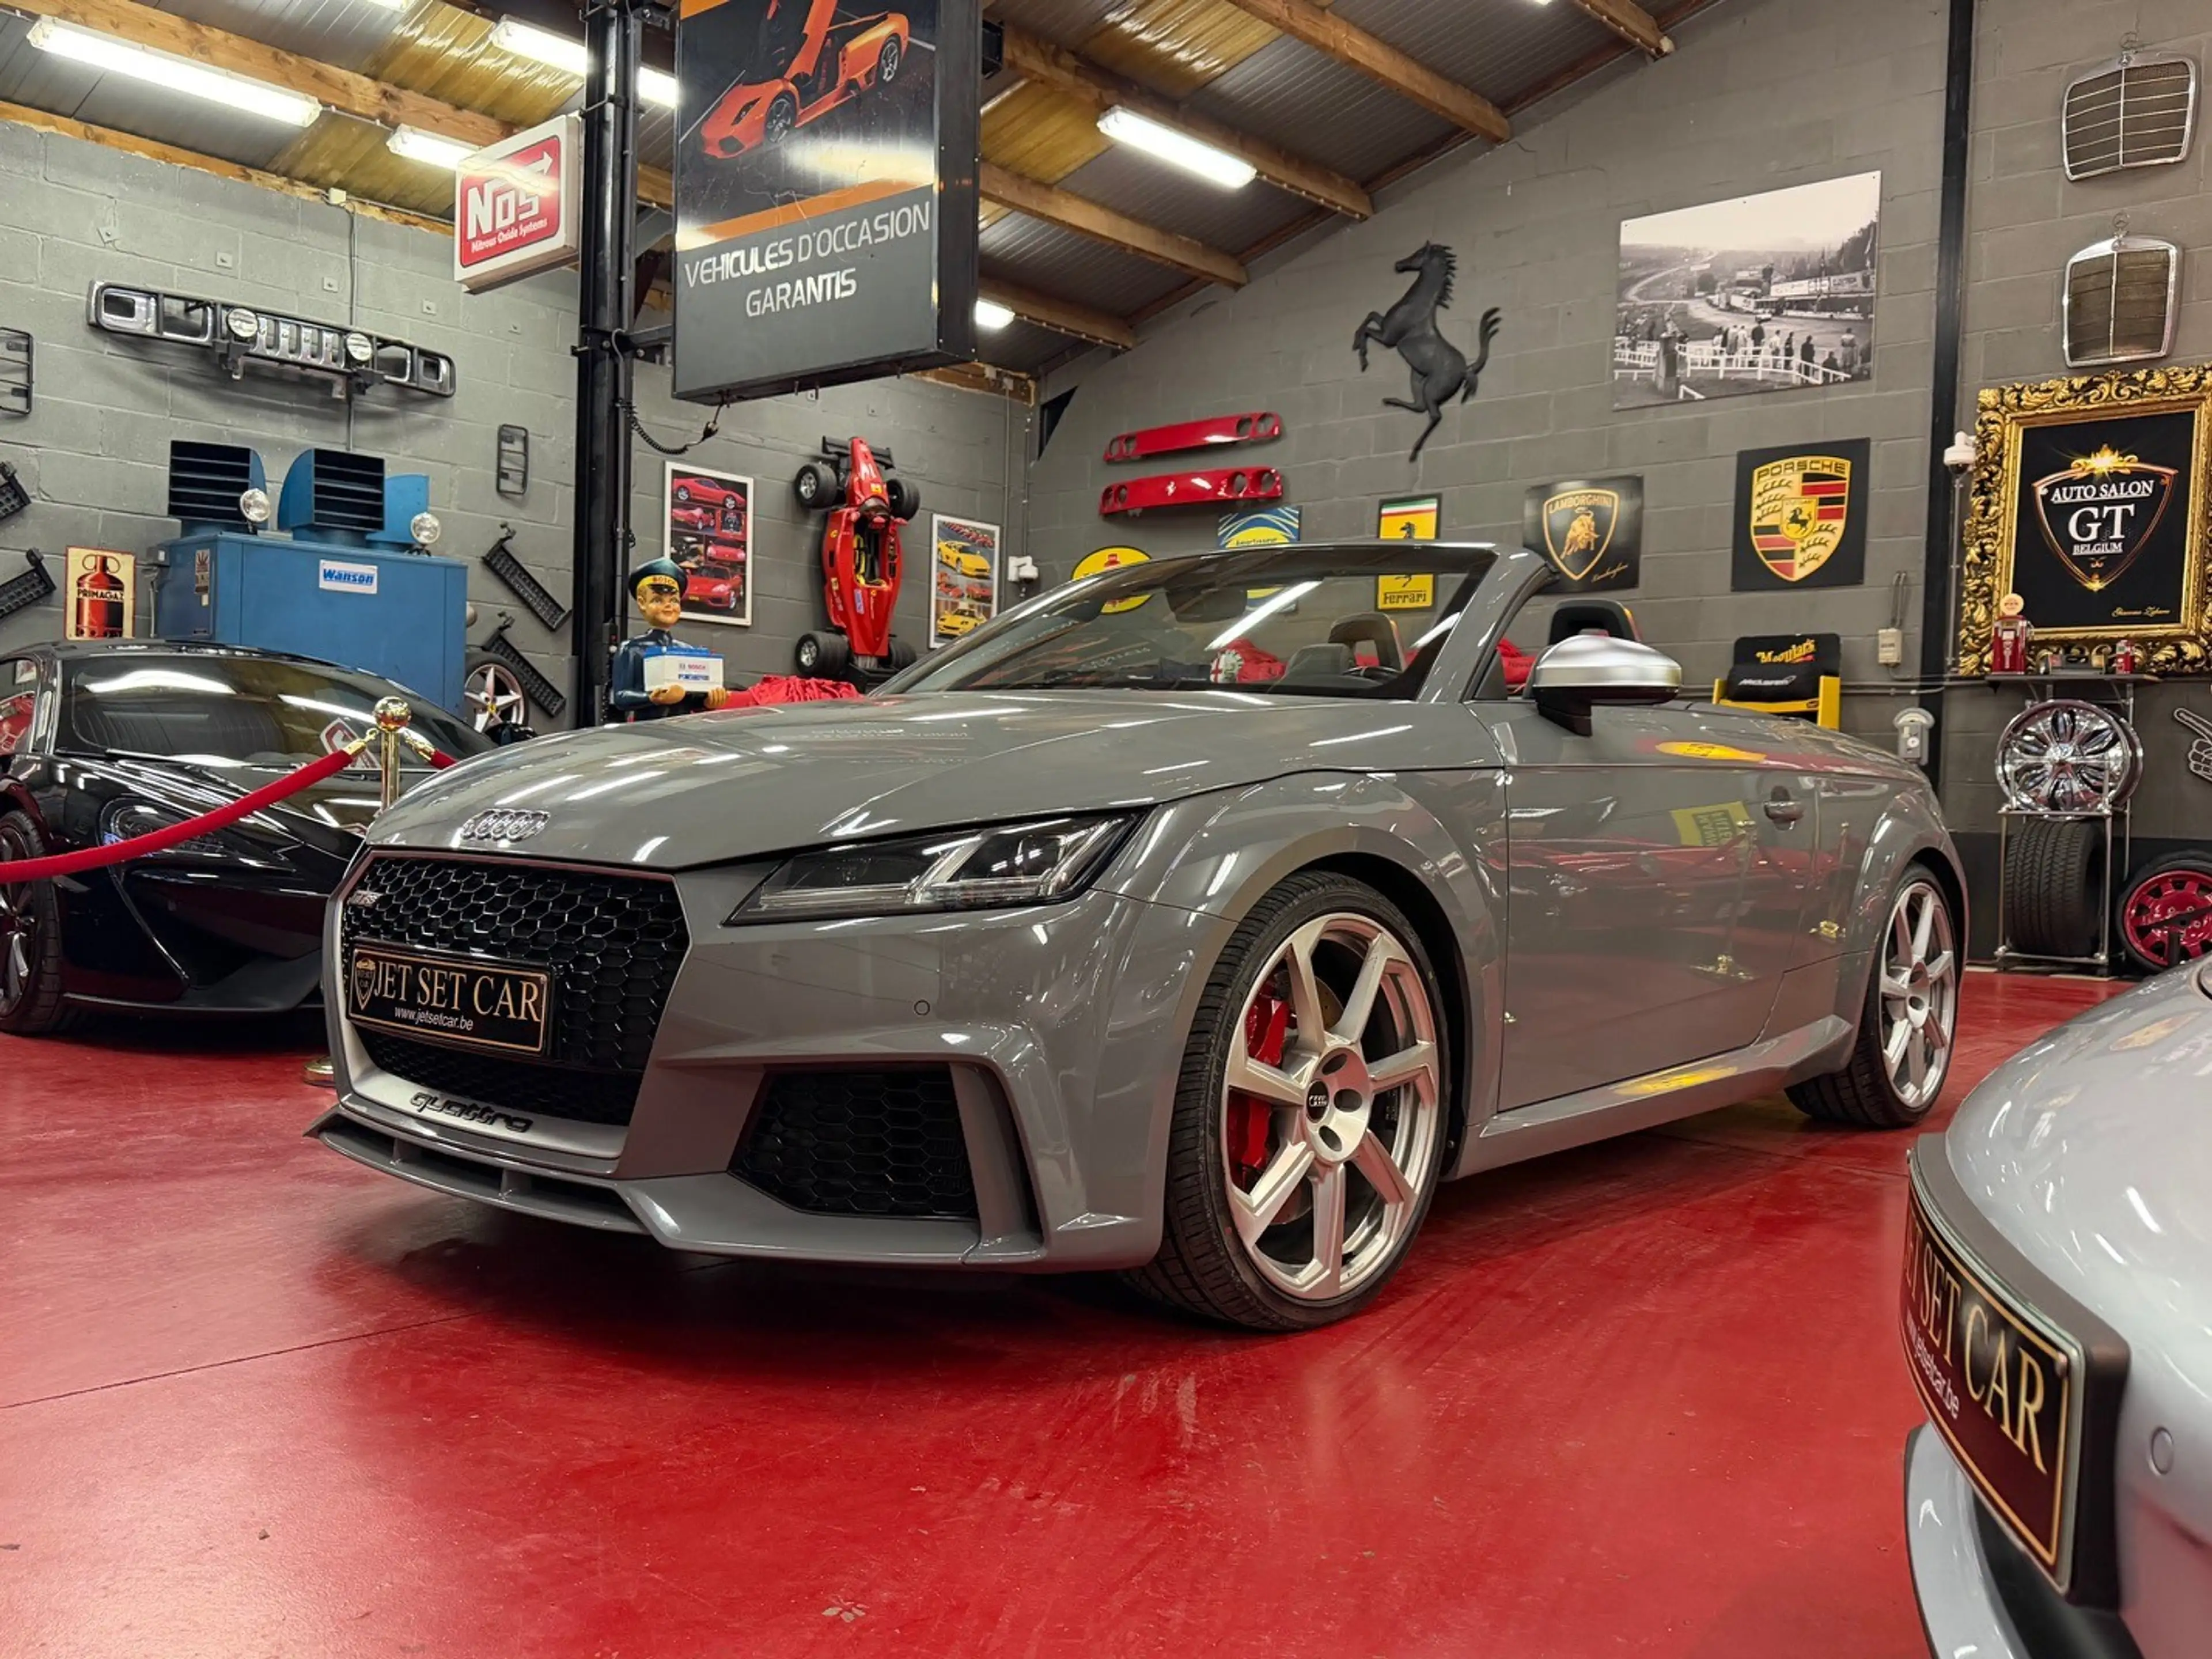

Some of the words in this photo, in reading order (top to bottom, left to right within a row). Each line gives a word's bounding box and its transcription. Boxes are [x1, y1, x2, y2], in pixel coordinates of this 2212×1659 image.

[471, 237, 497, 253] Nitrous
[497, 228, 518, 244] Oxide
[519, 218, 548, 238] Systems
[684, 237, 793, 288] VEHICULES
[797, 201, 930, 263] D'OCCASION
[746, 267, 857, 317] GARANTIS
[1756, 459, 1846, 483] PORSCHE
[2051, 484, 2096, 501] AUTO
[2099, 479, 2155, 497] SALON
[1549, 494, 1612, 514] LAMBORGHINI
[2068, 503, 2135, 541] GT
[2073, 541, 2123, 554] BELGIUM
[323, 568, 374, 585] Wanson
[77, 586, 124, 601] PRIMAGAZ
[1383, 589, 1427, 605] Ferrari
[1738, 677, 1790, 685] McLaren
[374, 960, 412, 1002] JET
[417, 967, 467, 1011] SET
[474, 975, 541, 1022] CAR
[394, 1005, 474, 1031] www.jetsetcar.be
[410, 1091, 534, 1133] quattro
[1920, 1241, 1961, 1368] SET
[1964, 1303, 2047, 1474] CAR
